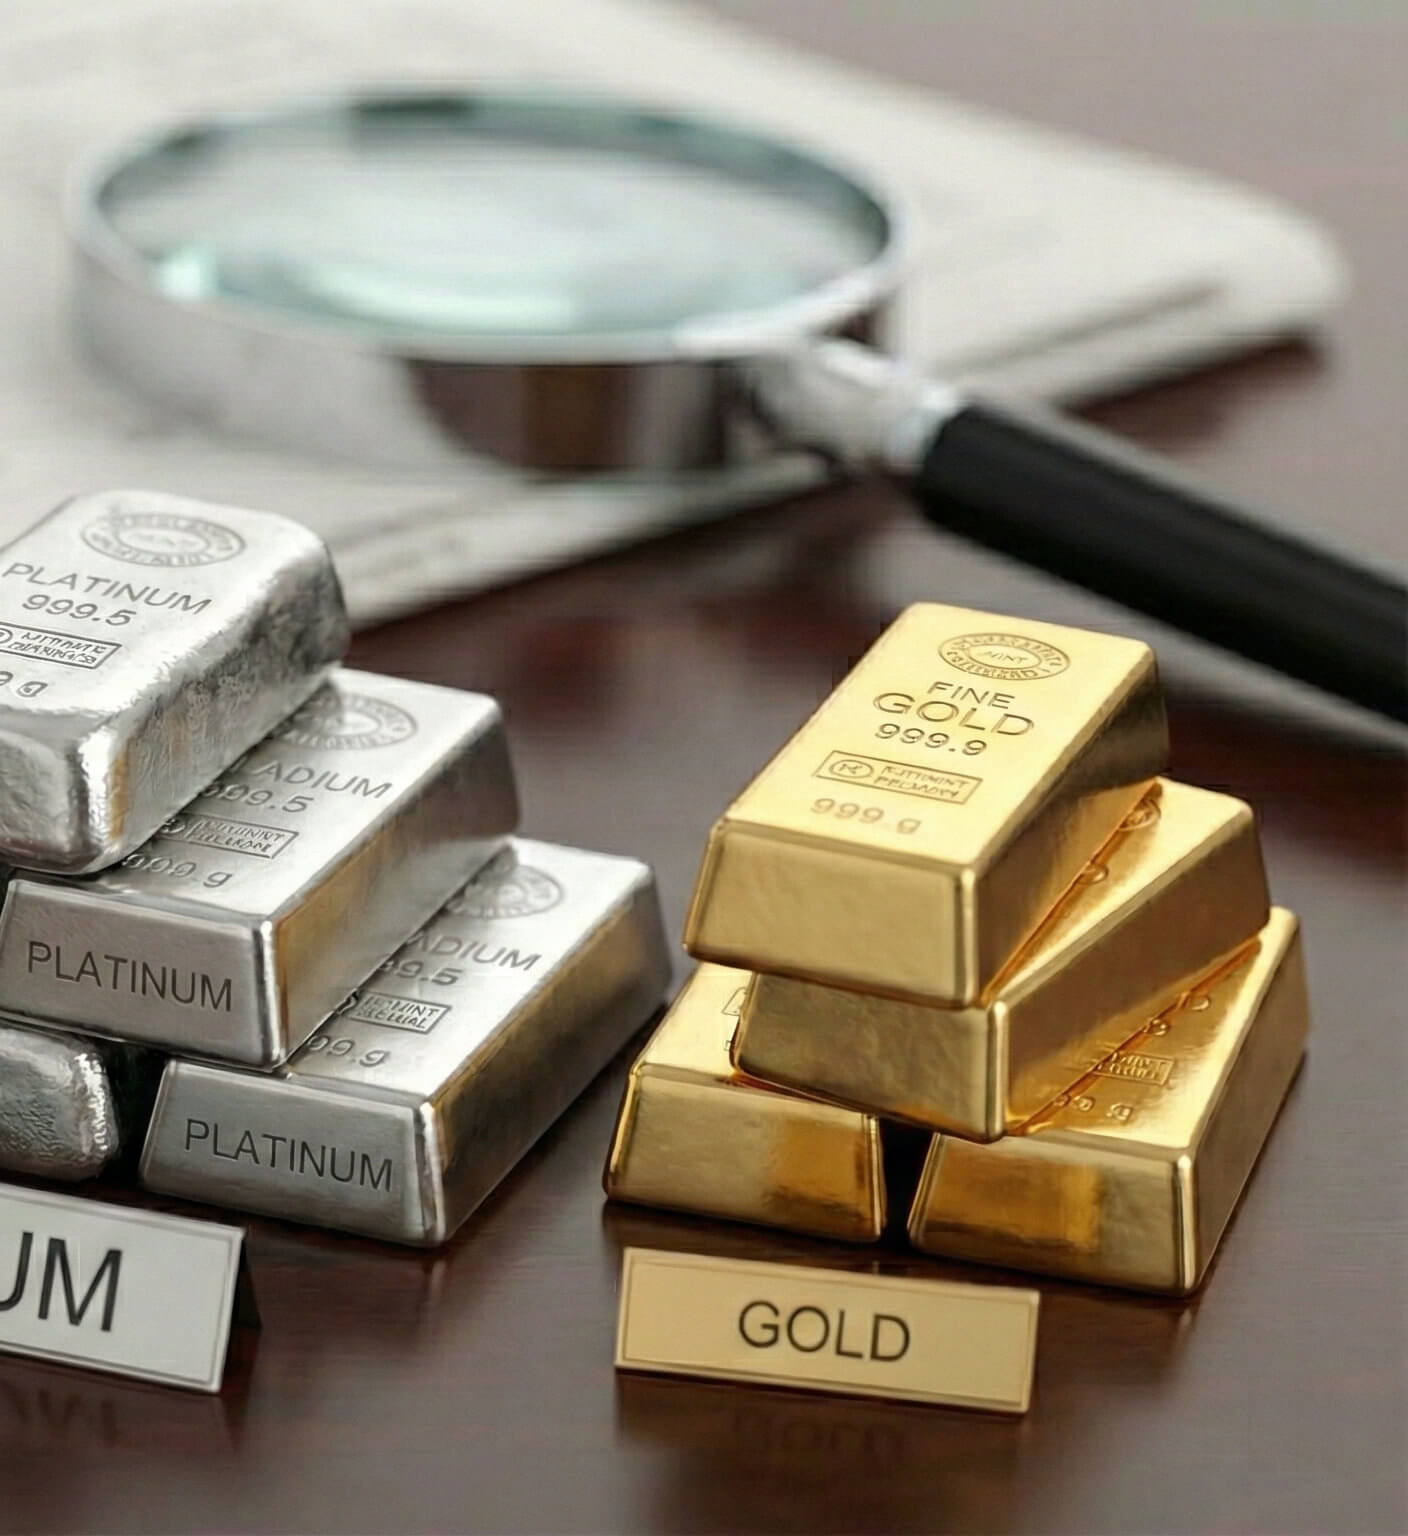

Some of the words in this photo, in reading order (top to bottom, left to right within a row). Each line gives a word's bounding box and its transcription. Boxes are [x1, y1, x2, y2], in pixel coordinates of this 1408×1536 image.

[1, 562, 213, 615] PLATINUM
[22, 593, 137, 626] 999.5
[873, 691, 1035, 736] GOLD
[927, 681, 1016, 710] FINE
[874, 723, 988, 756] 999.9
[810, 797, 885, 824] 999
[27, 940, 233, 1013] PLATINUM
[185, 1118, 393, 1192] PLATINUM
[738, 1300, 911, 1363] GOLD
